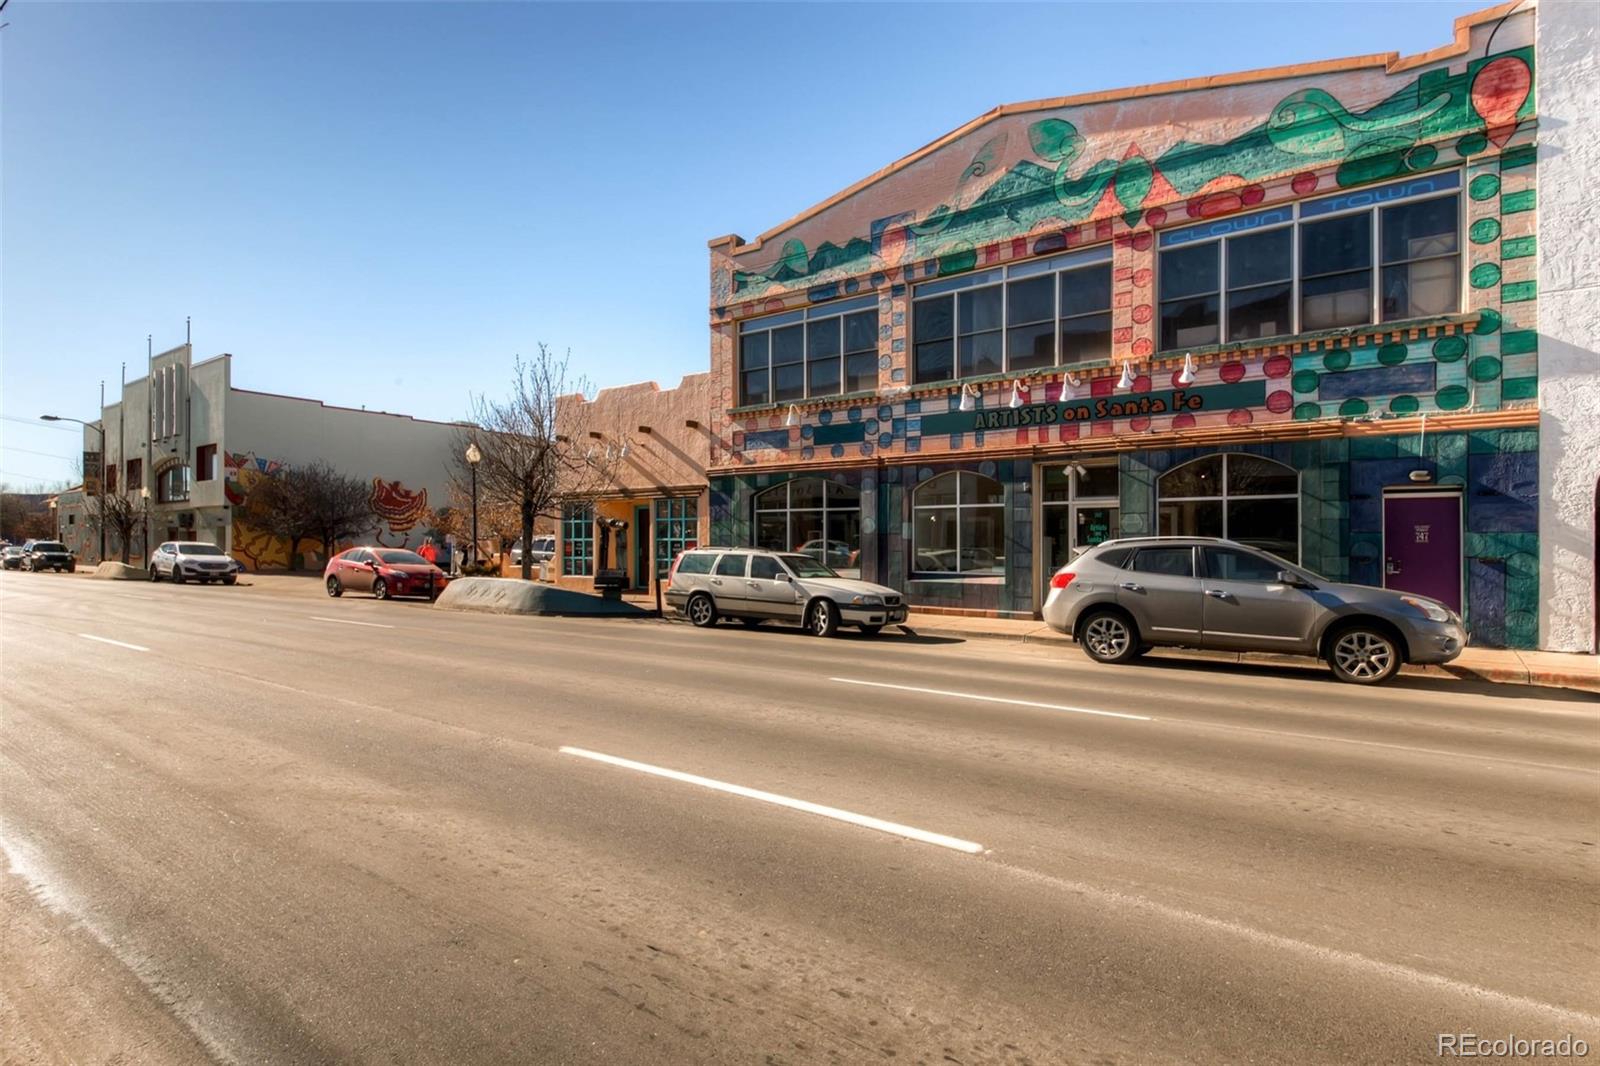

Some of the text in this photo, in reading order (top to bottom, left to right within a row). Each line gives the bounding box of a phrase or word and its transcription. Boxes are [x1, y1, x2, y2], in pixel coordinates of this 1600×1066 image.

[1168, 181, 1435, 244] CLOWN TOWN
[974, 391, 1204, 430] ARTISTS on Santa Fe
